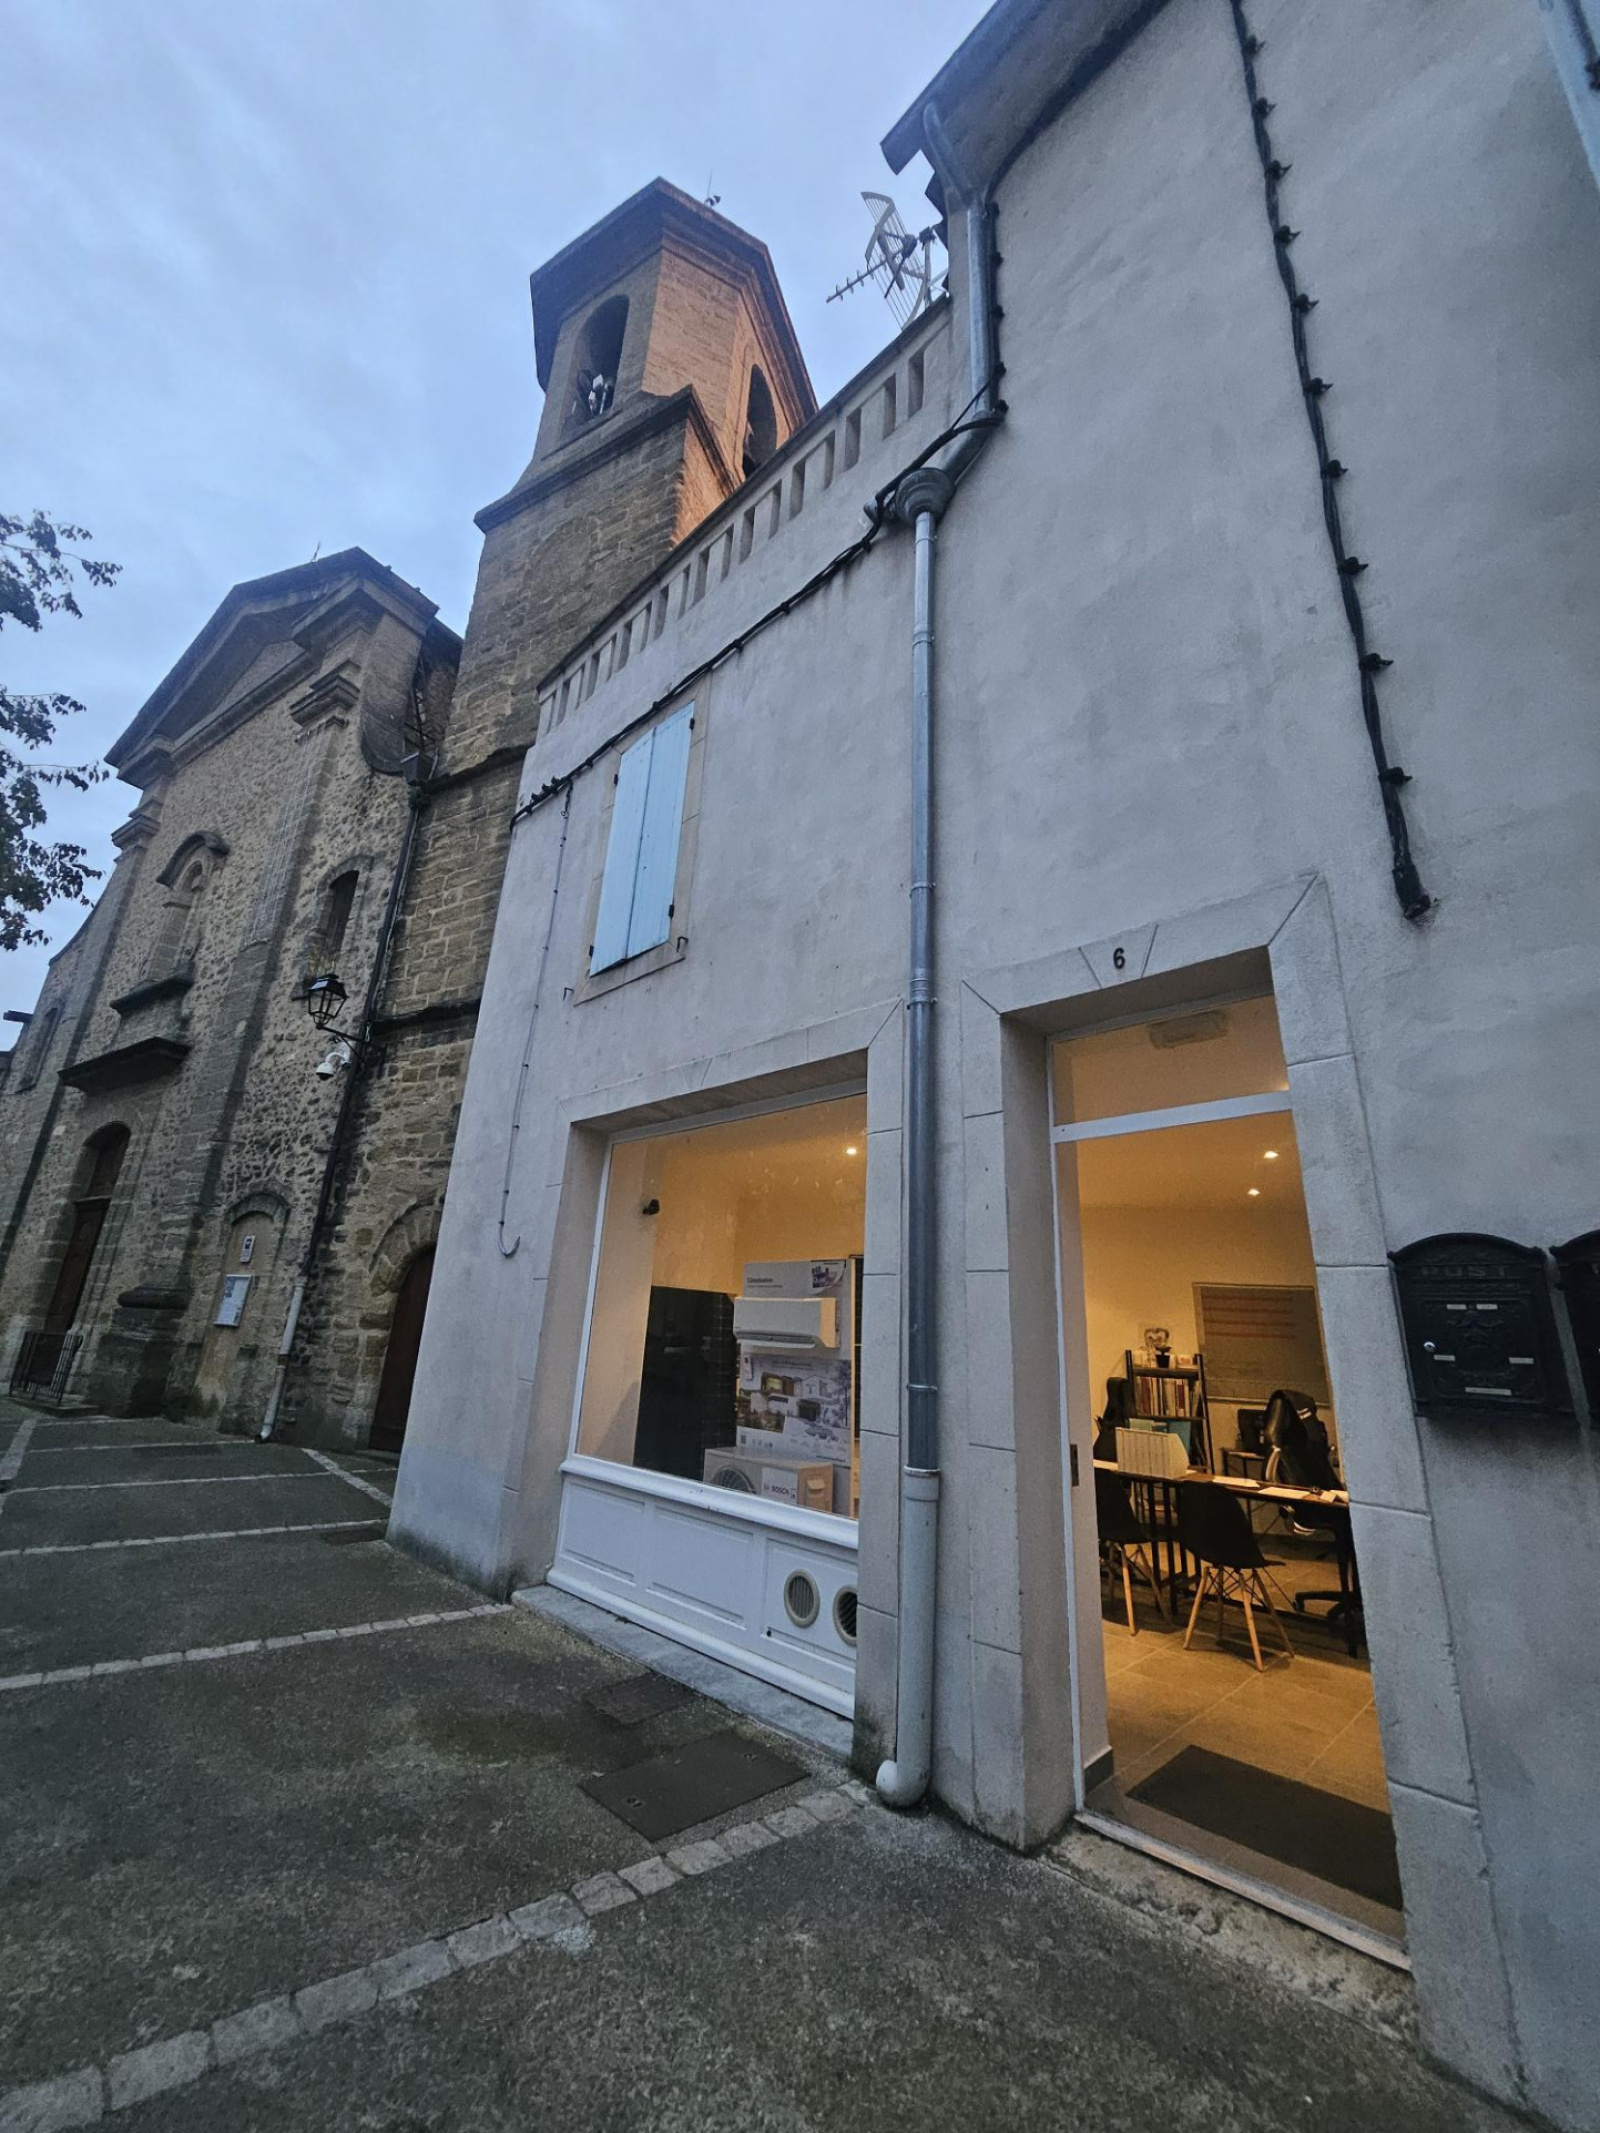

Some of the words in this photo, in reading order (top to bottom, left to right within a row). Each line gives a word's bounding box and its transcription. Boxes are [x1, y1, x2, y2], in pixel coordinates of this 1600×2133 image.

[1113, 947, 1125, 970] 6
[1421, 1265, 1511, 1278] POST
[771, 1485, 789, 1496] BOSCH
